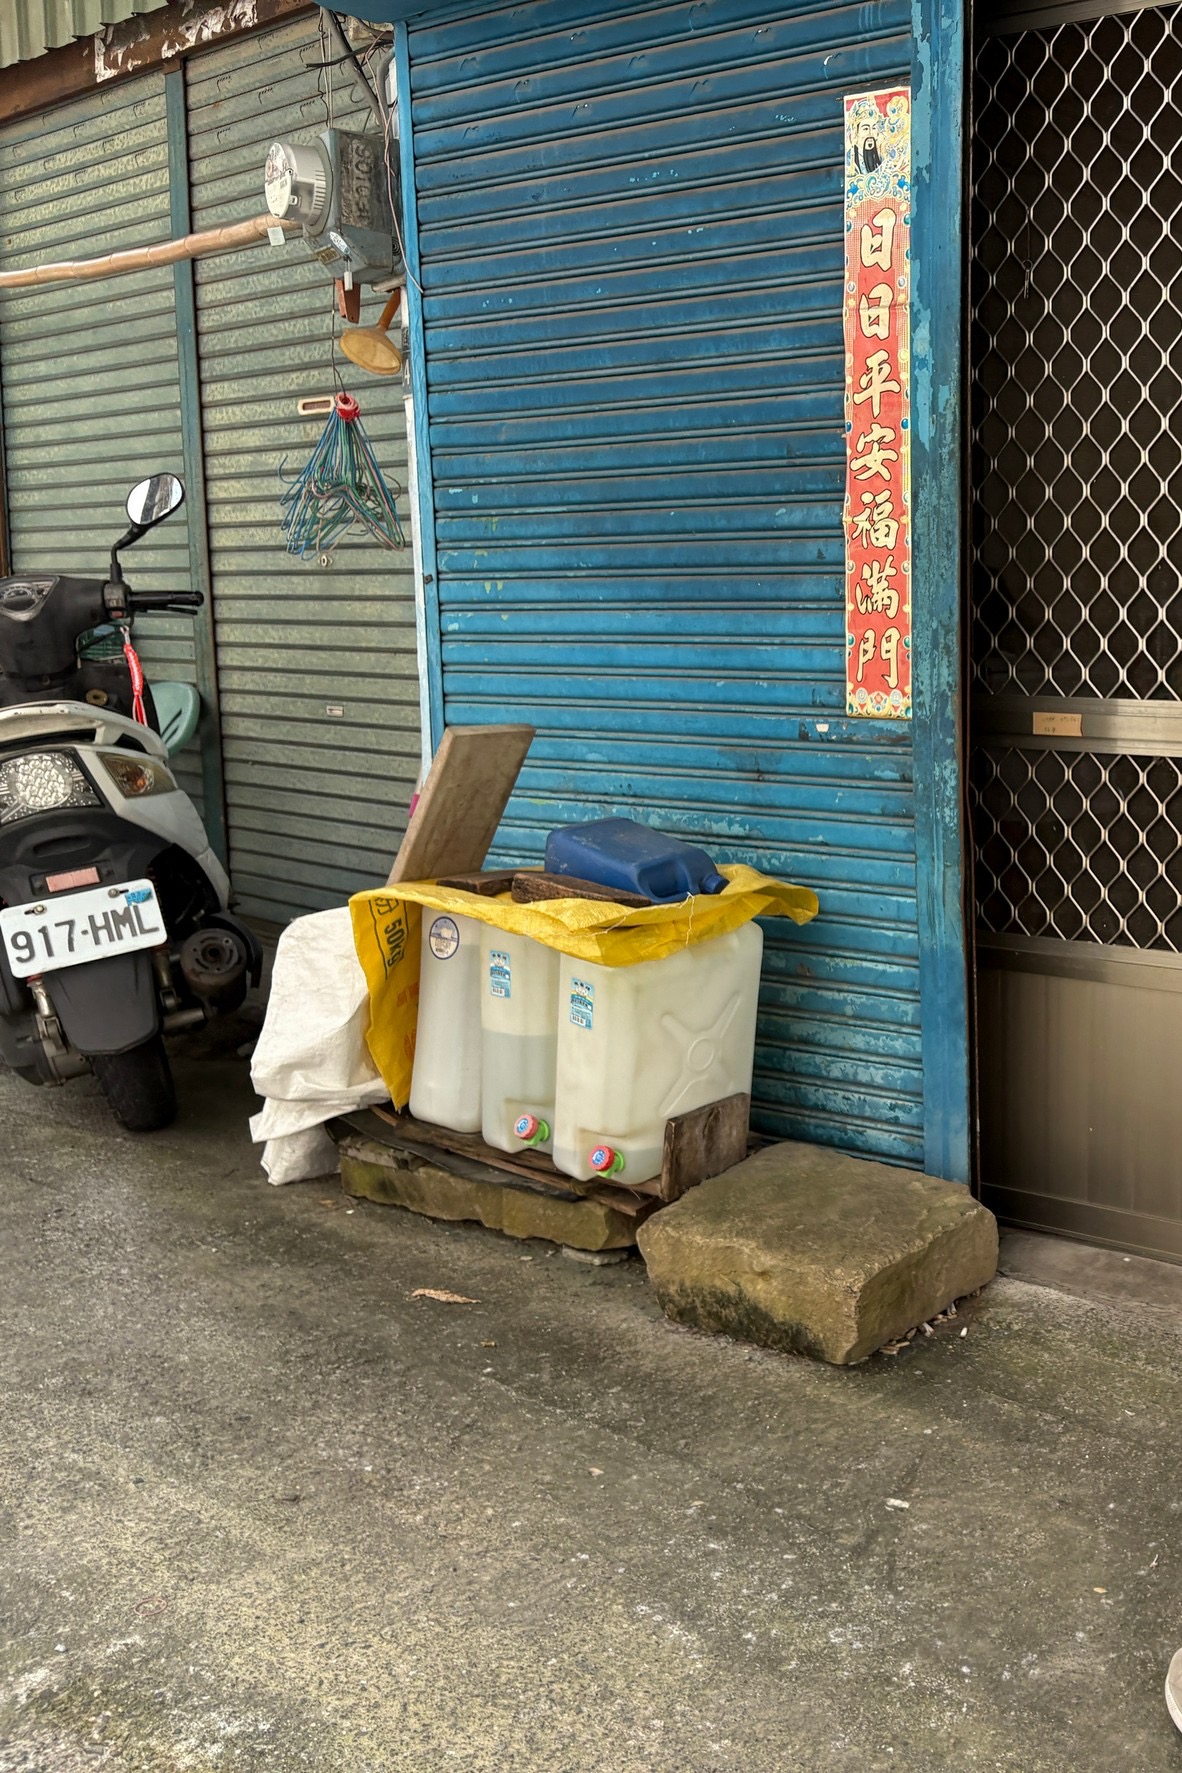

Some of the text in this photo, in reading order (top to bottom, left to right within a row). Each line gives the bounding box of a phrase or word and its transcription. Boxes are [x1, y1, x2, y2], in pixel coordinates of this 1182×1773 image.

[851, 207, 901, 689] 日日平安福滿門
[10, 904, 160, 964] 917-HML
